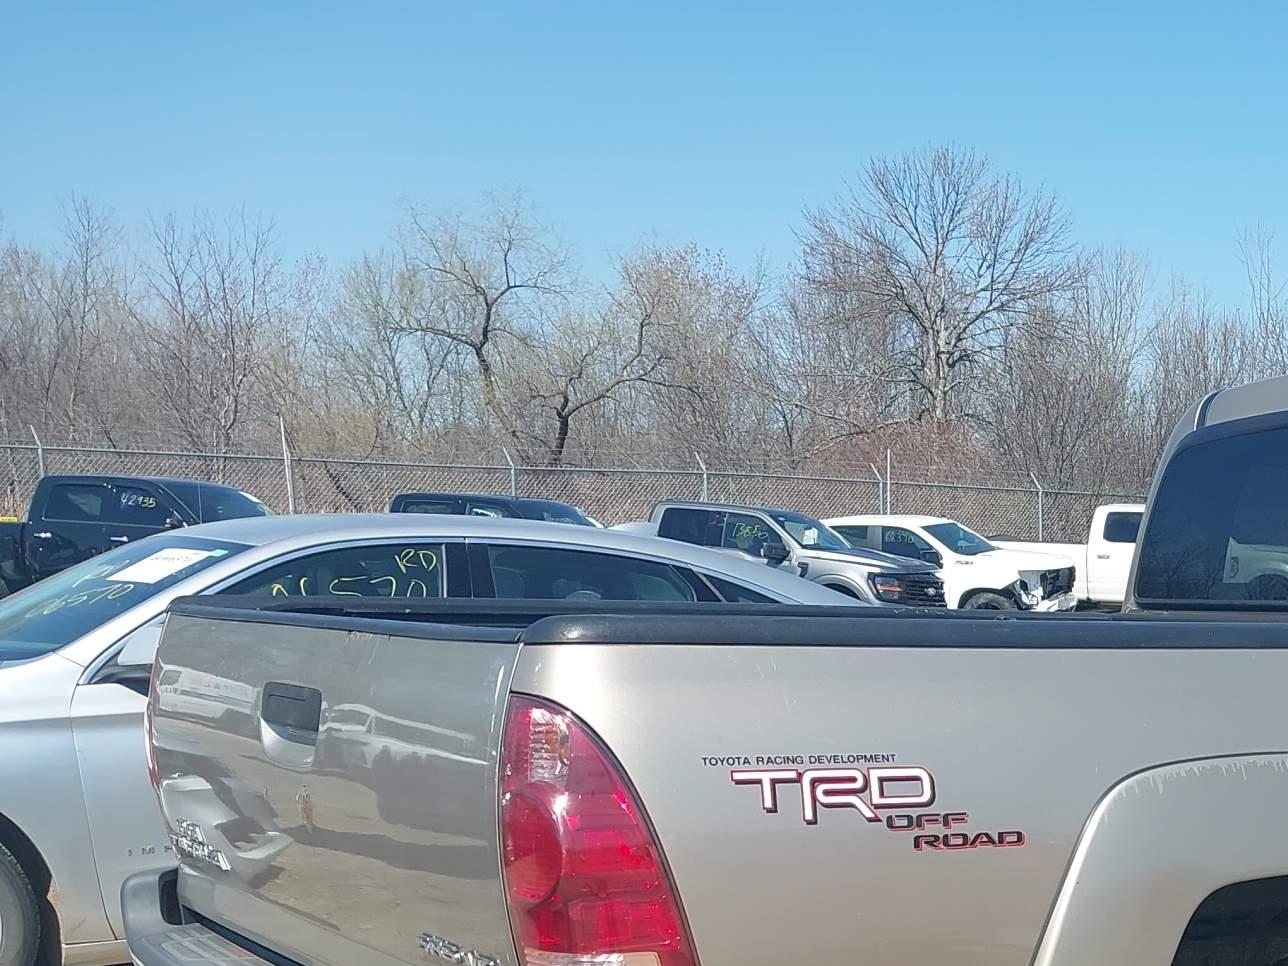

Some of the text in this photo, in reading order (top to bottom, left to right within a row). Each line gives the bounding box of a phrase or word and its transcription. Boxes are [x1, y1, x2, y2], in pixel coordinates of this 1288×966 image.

[394, 549, 437, 574] RD
[701, 754, 896, 767] TOYOTA RACING DEVELOPMENT
[730, 767, 936, 826] TRD
[885, 812, 969, 832] OFF
[913, 831, 1025, 851] ROAD
